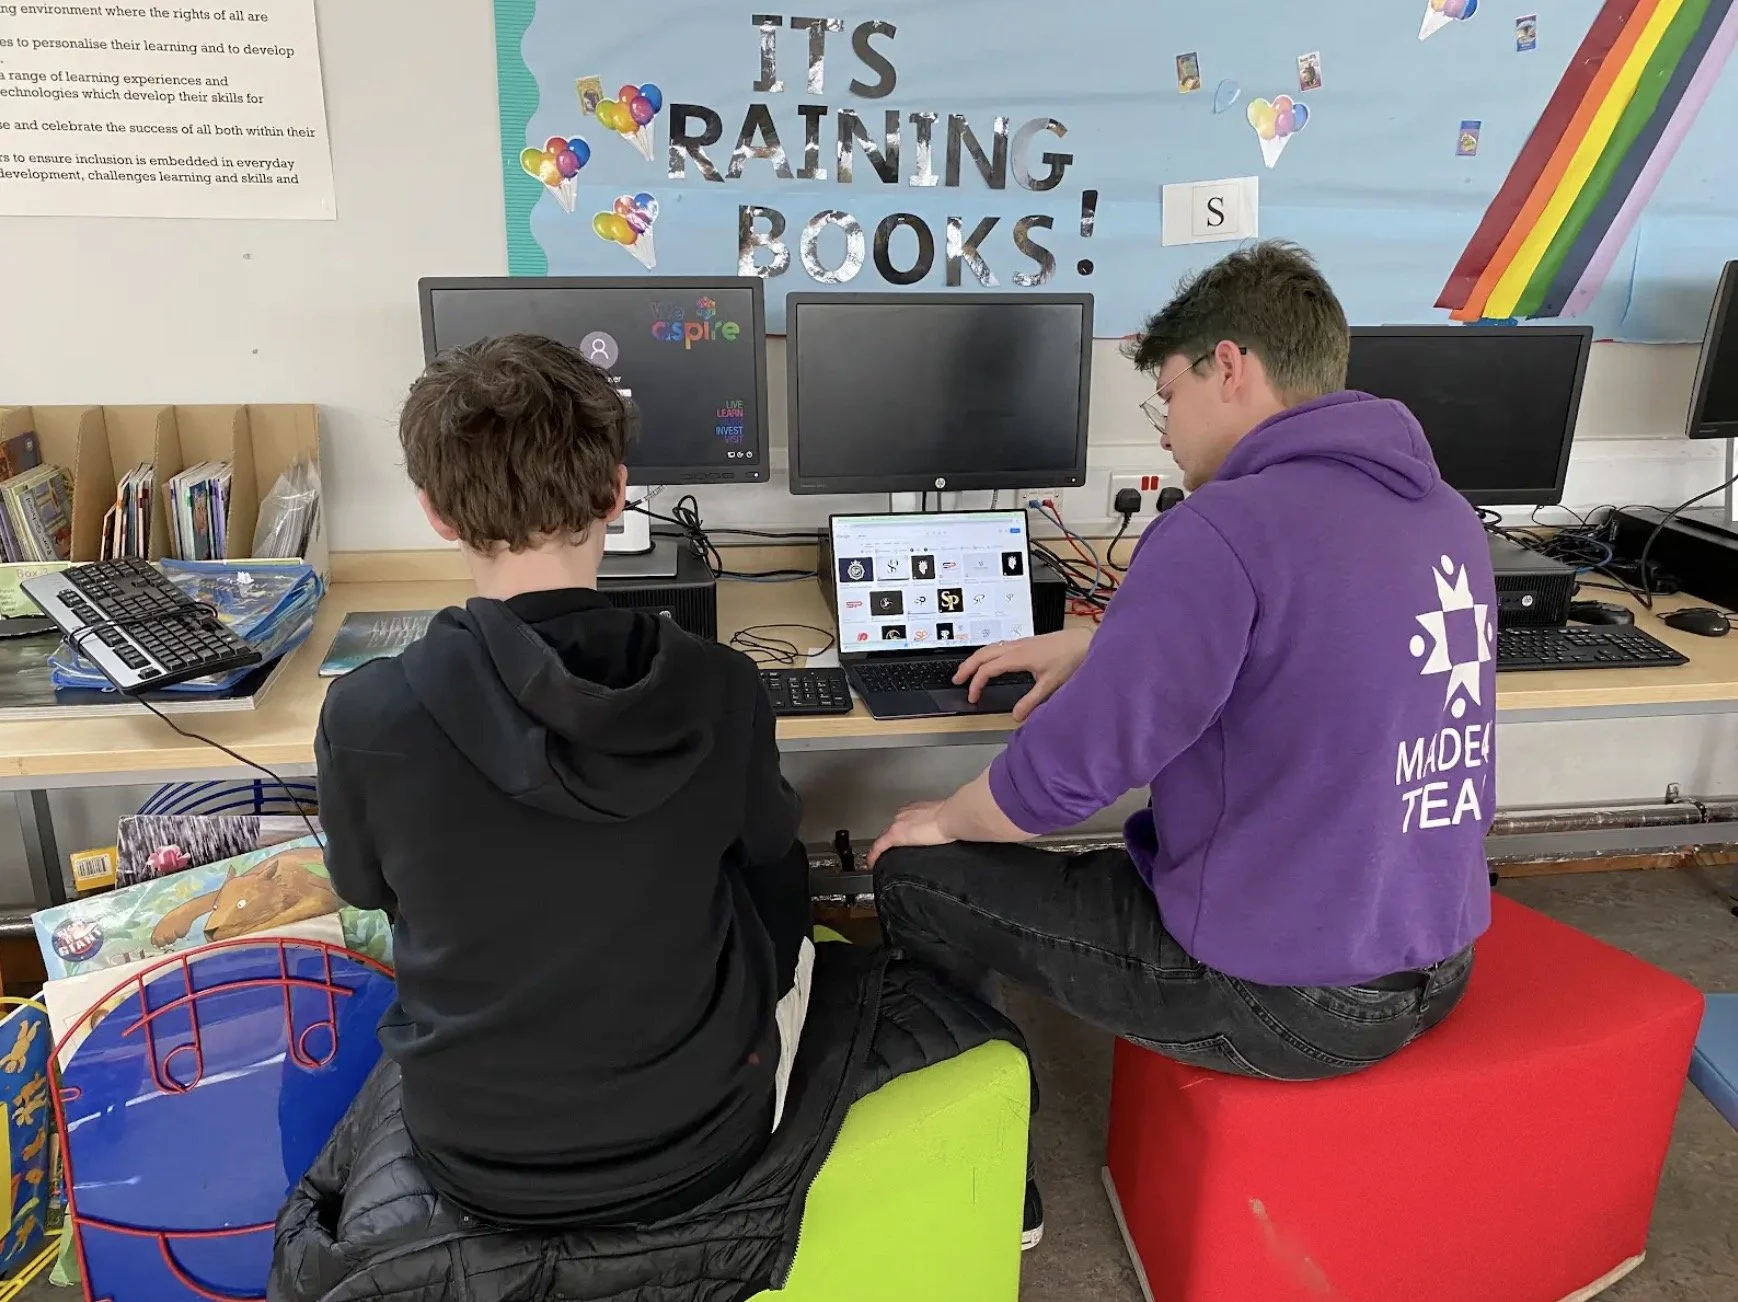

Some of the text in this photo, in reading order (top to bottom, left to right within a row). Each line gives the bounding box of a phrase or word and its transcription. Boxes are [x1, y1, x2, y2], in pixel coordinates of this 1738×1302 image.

[21, 4, 102, 16] environment
[105, 6, 147, 17] where
[150, 7, 170, 18] the
[173, 9, 210, 22] rights
[213, 10, 226, 21] of
[229, 11, 244, 21] all
[248, 13, 268, 22] are
[17, 38, 29, 47] to
[33, 39, 107, 50] personalise
[111, 40, 141, 51] their
[144, 41, 197, 55] learning
[201, 44, 225, 53] and
[228, 44, 240, 54] to
[243, 45, 295, 59] develop
[752, 14, 897, 98] ITS
[8, 72, 47, 83] range
[50, 72, 63, 82] of
[66, 72, 119, 86] learning
[123, 75, 202, 87] experiences
[205, 77, 229, 86] and
[82, 88, 121, 100] which
[124, 91, 175, 104] develop
[179, 92, 208, 103] their
[211, 93, 244, 104] skills
[246, 94, 264, 104] for
[14, 120, 38, 130] and
[42, 120, 103, 132] celebrate
[106, 122, 126, 133] the
[129, 125, 178, 134] success
[181, 124, 194, 134] of
[197, 124, 211, 135] all
[215, 125, 244, 136] both
[246, 126, 285, 137] within
[287, 127, 316, 138] their
[668, 103, 1074, 192] RAINING
[13, 154, 25, 163] to
[29, 155, 72, 164] ensure
[76, 154, 133, 165] inclusion
[136, 155, 146, 165] is
[150, 156, 218, 167] embedded
[222, 157, 234, 167] in
[237, 158, 295, 171] everyday
[88, 170, 157, 184] challenges
[160, 171, 212, 185] learning
[215, 173, 238, 183] and
[242, 174, 273, 184] skills
[276, 174, 299, 184] and
[1207, 197, 1225, 227] S
[737, 190, 1098, 287] BOOKS!
[716, 409, 744, 418] LEARN
[715, 426, 744, 435] INVEST
[16, 568, 37, 578] Box
[941, 591, 960, 610] SP
[1401, 774, 1487, 834] TEA
